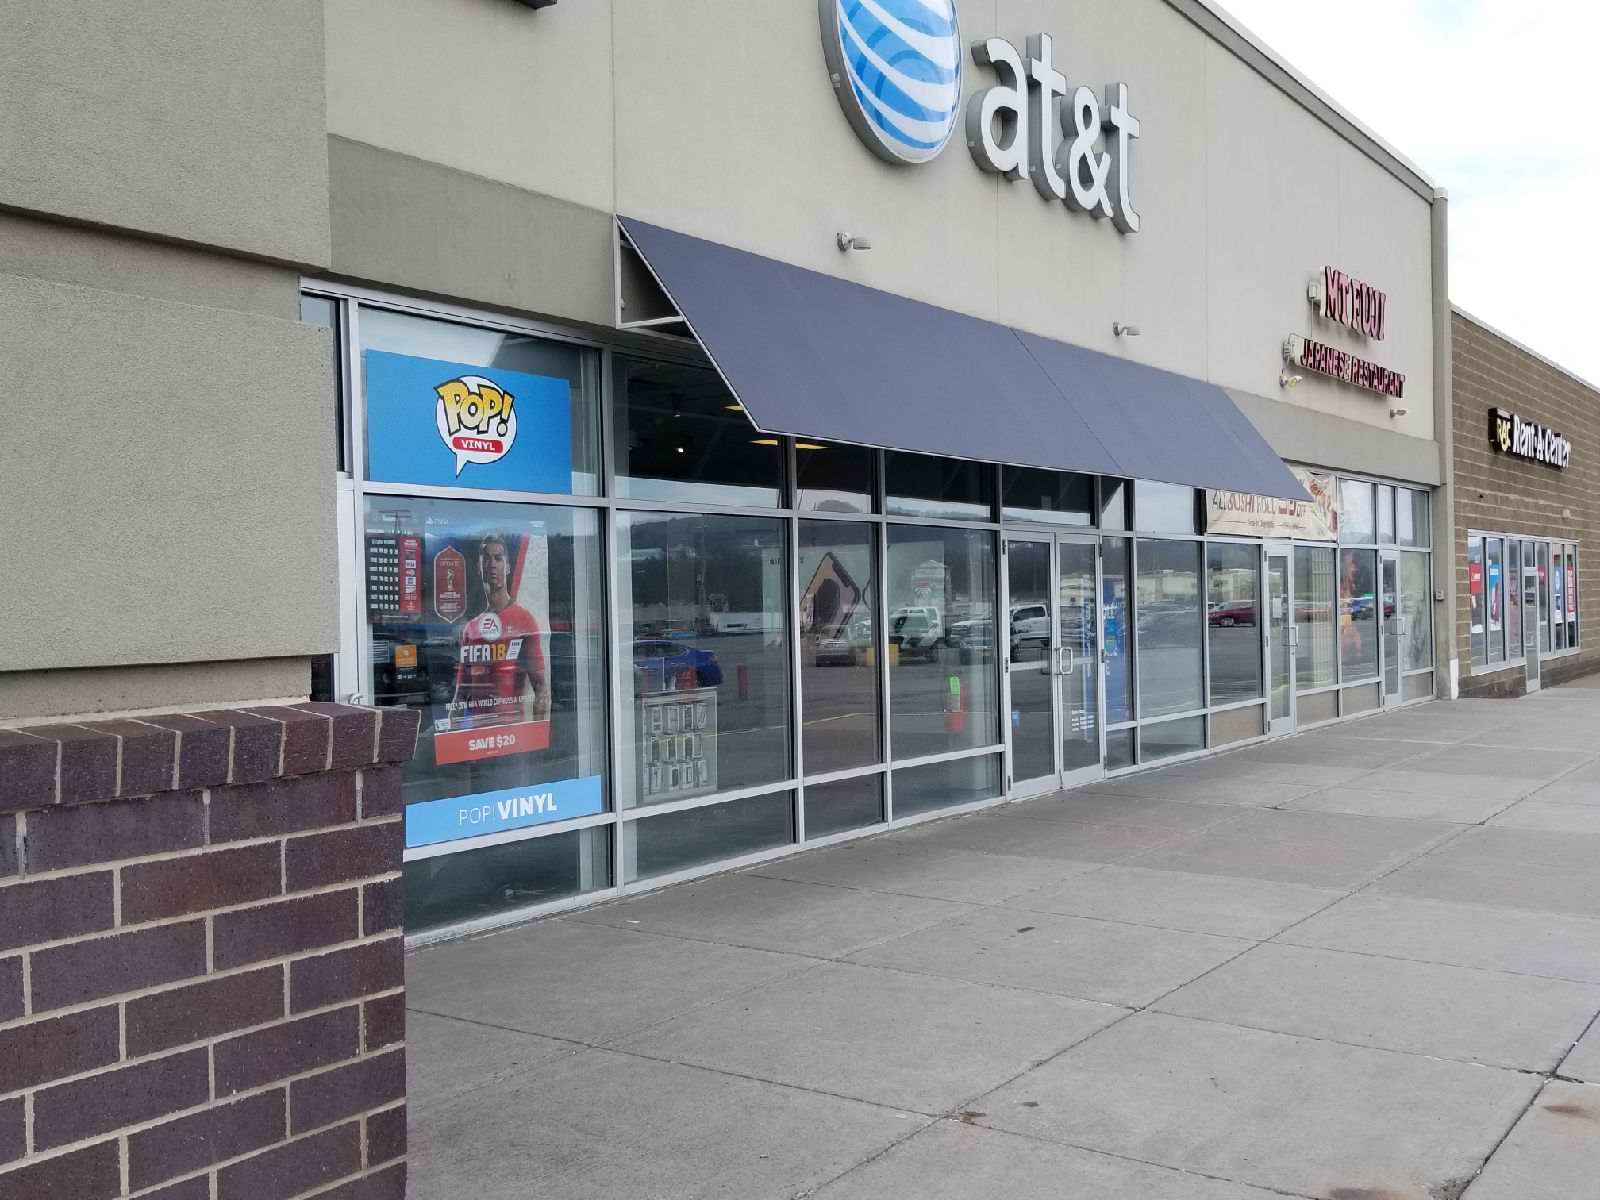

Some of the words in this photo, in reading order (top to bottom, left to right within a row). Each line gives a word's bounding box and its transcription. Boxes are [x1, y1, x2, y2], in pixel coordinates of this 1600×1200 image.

[966, 32, 1141, 233] at&t
[1325, 265, 1349, 325] MT
[1351, 279, 1387, 341] FUJI
[1300, 339, 1350, 381] JAPANESE
[1350, 356, 1405, 398] RESTAURANT
[434, 379, 516, 438] POP!
[460, 438, 496, 452] VINYL
[1228, 494, 1254, 513] SUSHI
[468, 736, 495, 751] SAVE
[496, 734, 515, 749] $20
[497, 792, 558, 820] VINYL
